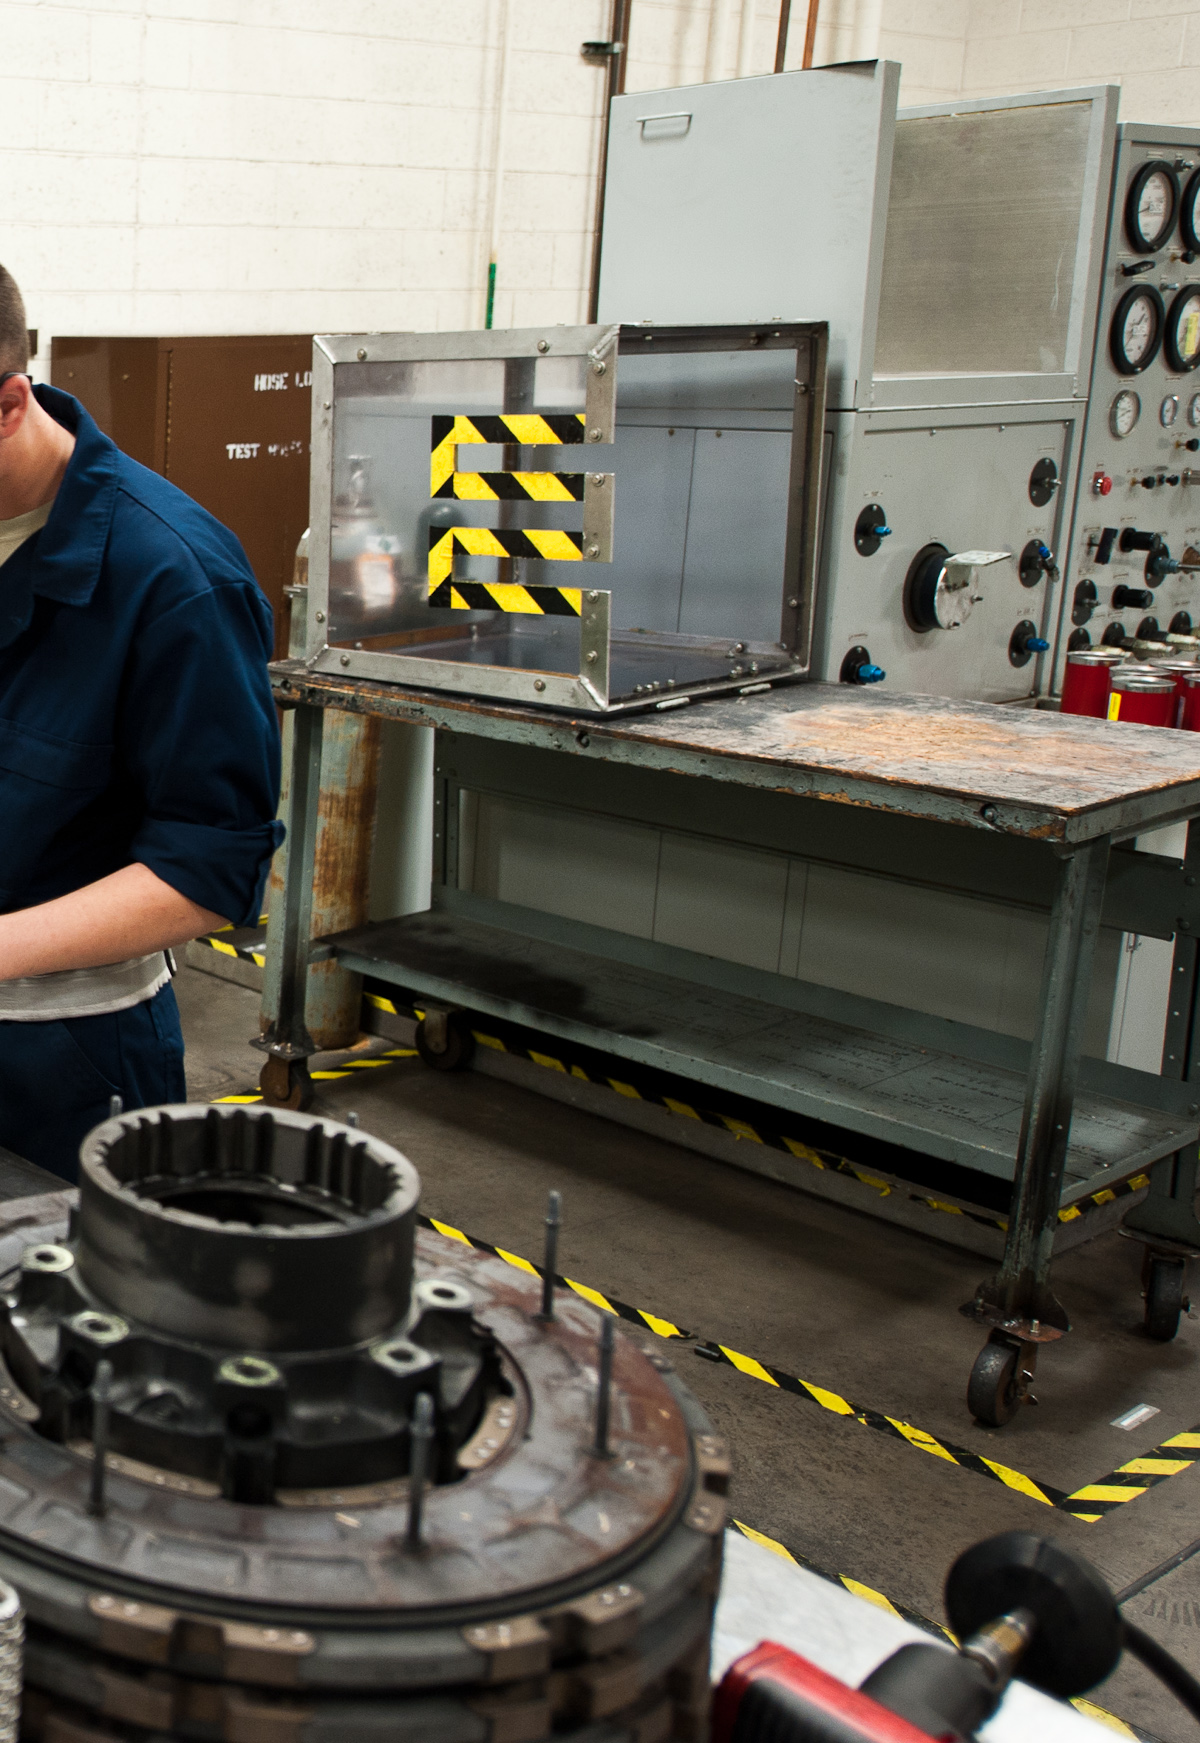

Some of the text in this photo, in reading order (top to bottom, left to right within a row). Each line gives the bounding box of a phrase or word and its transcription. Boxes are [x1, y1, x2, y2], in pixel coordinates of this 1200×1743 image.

[254, 371, 312, 392] HOSE LO
[226, 443, 261, 460] TEST
